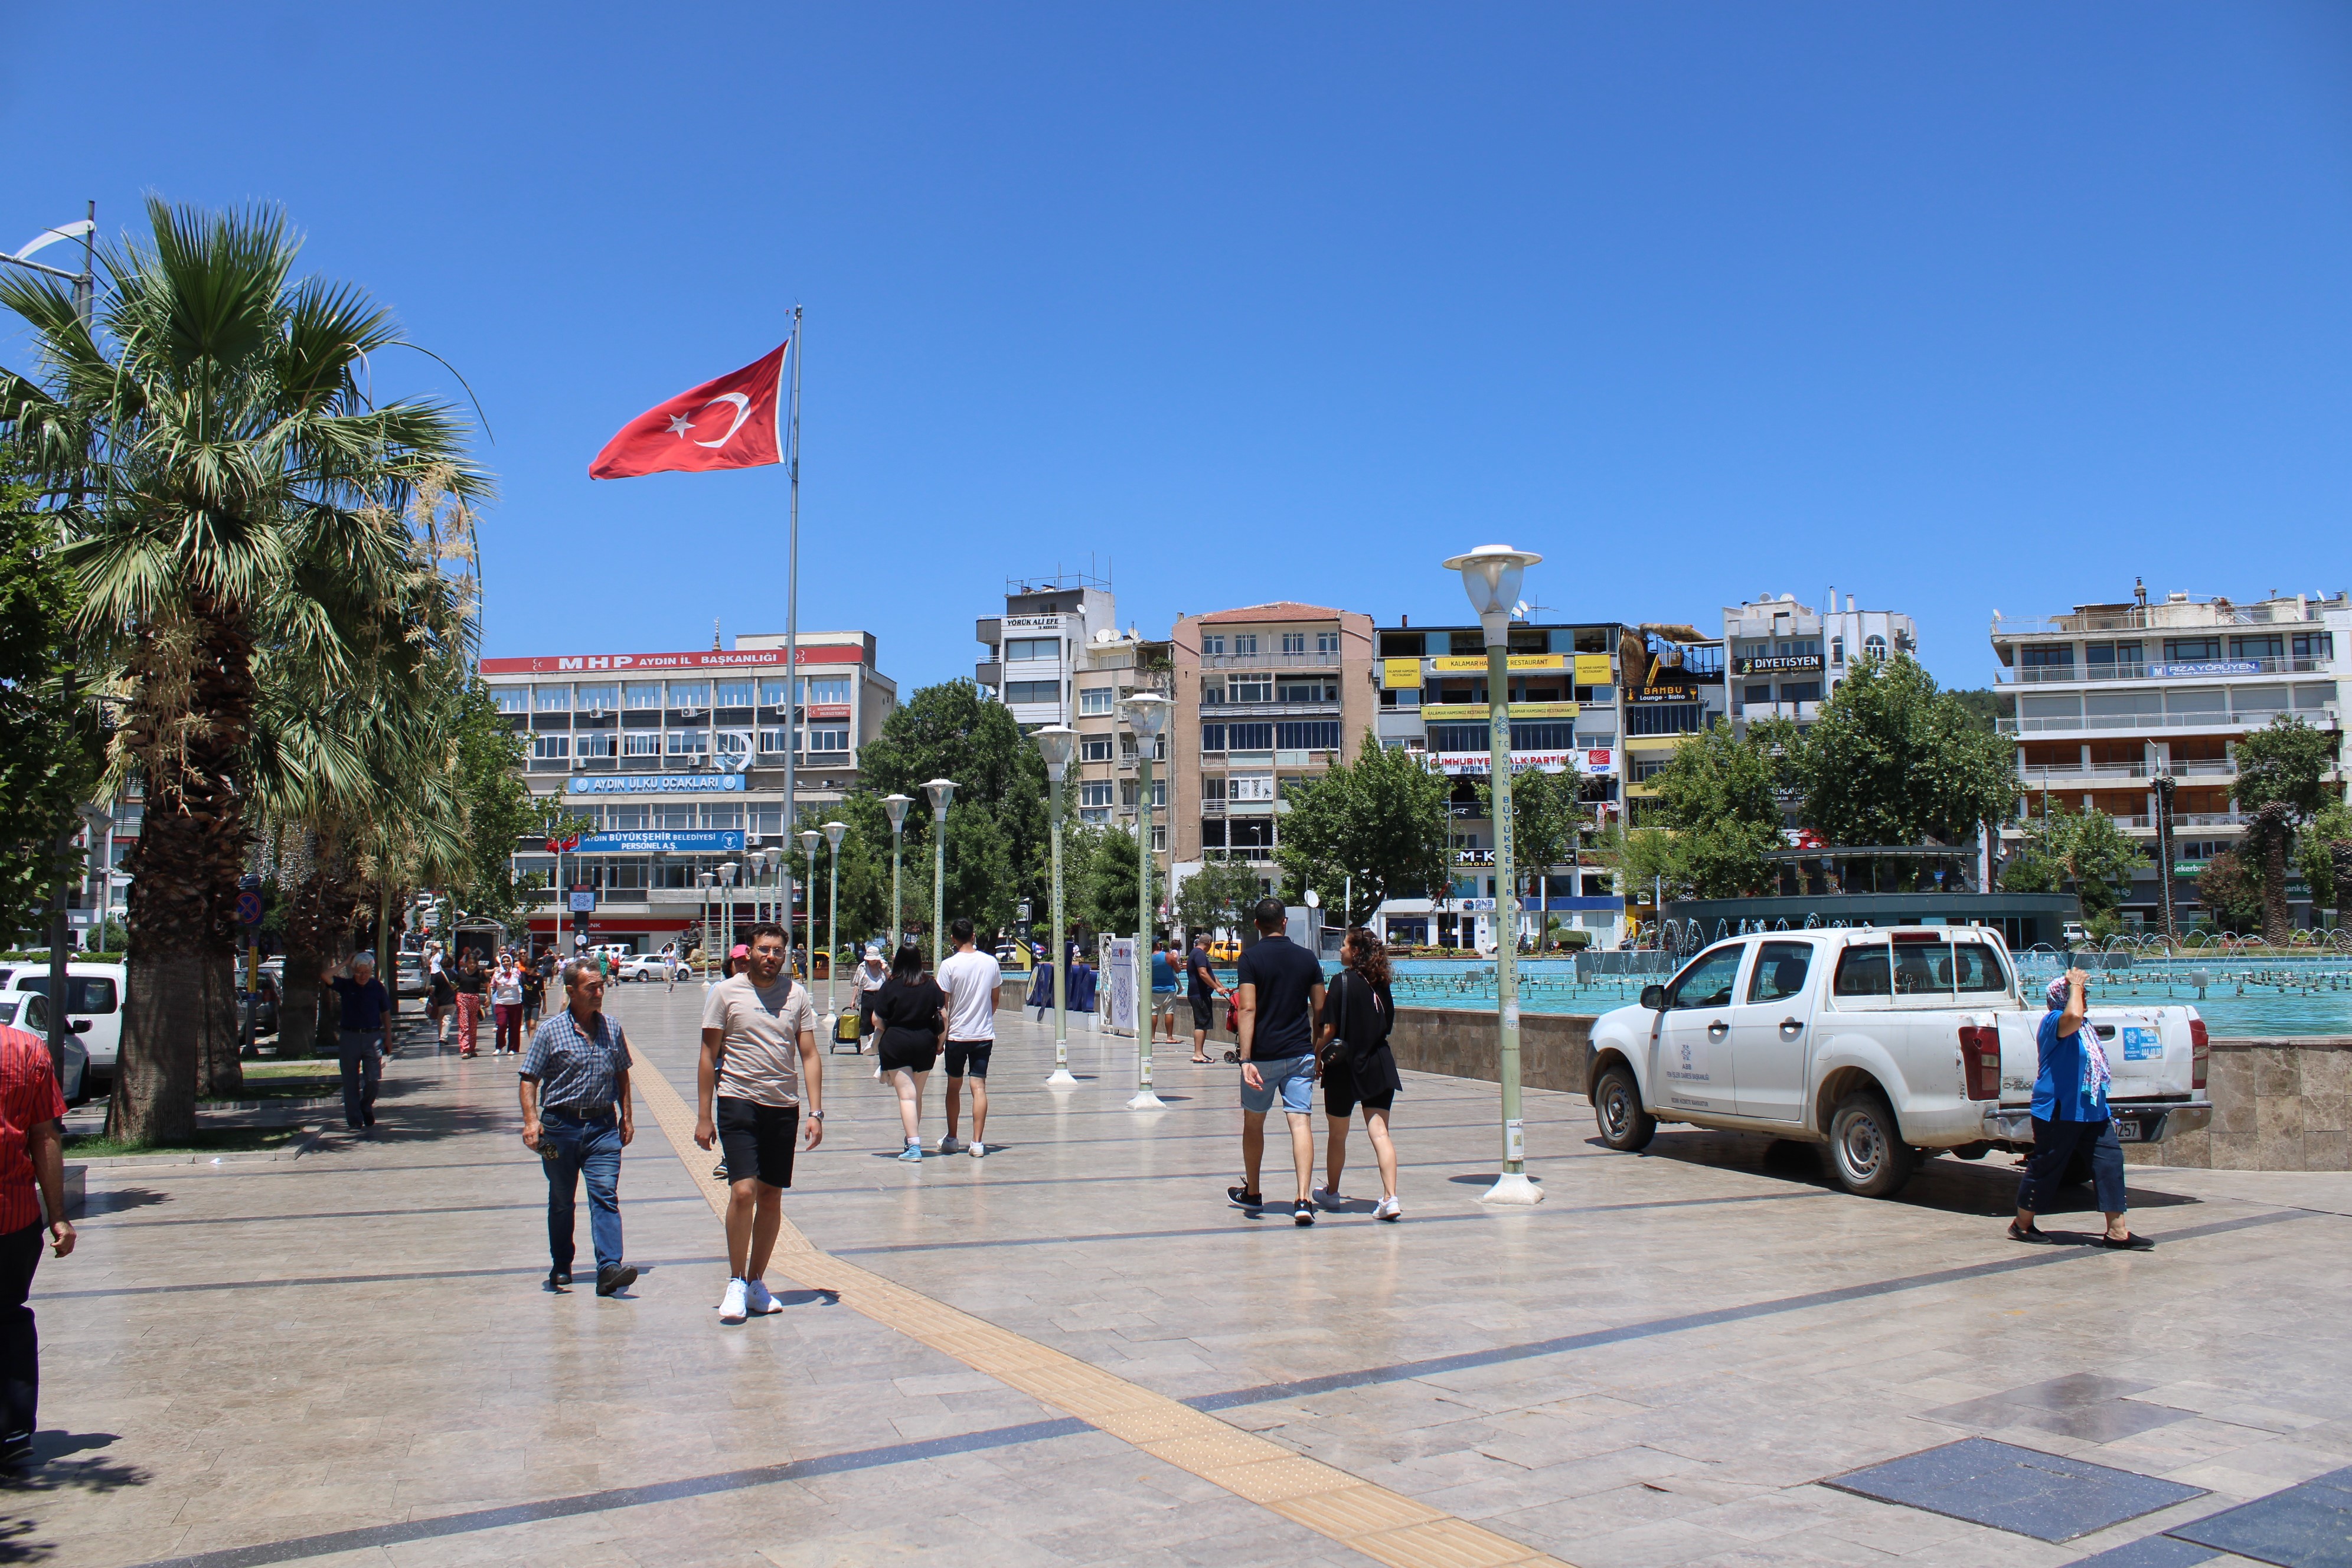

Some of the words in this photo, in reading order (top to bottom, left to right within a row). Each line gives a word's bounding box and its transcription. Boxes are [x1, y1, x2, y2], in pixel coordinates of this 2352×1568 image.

[559, 656, 633, 669] MHP
[639, 656, 675, 666] AYDIN
[680, 655, 691, 665] İL
[701, 652, 777, 665] BAŞKANLIĞI
[1755, 656, 1818, 668] DİYETİSYEN
[1430, 757, 1491, 766] CUMHURİYE
[594, 779, 625, 788] AYDIN
[629, 776, 658, 788] ÜLKÜ
[662, 777, 718, 787] OCAKLARI
[609, 832, 671, 842] BÜYÜKŞEHİR
[621, 842, 661, 850] PERSONEL
[662, 842, 677, 851] A.Ş.
[1503, 796, 1513, 896] BÜYÜKŞEHİR
[1475, 899, 1493, 907] QNB
[1507, 904, 1515, 994] BELEDİYESİ
